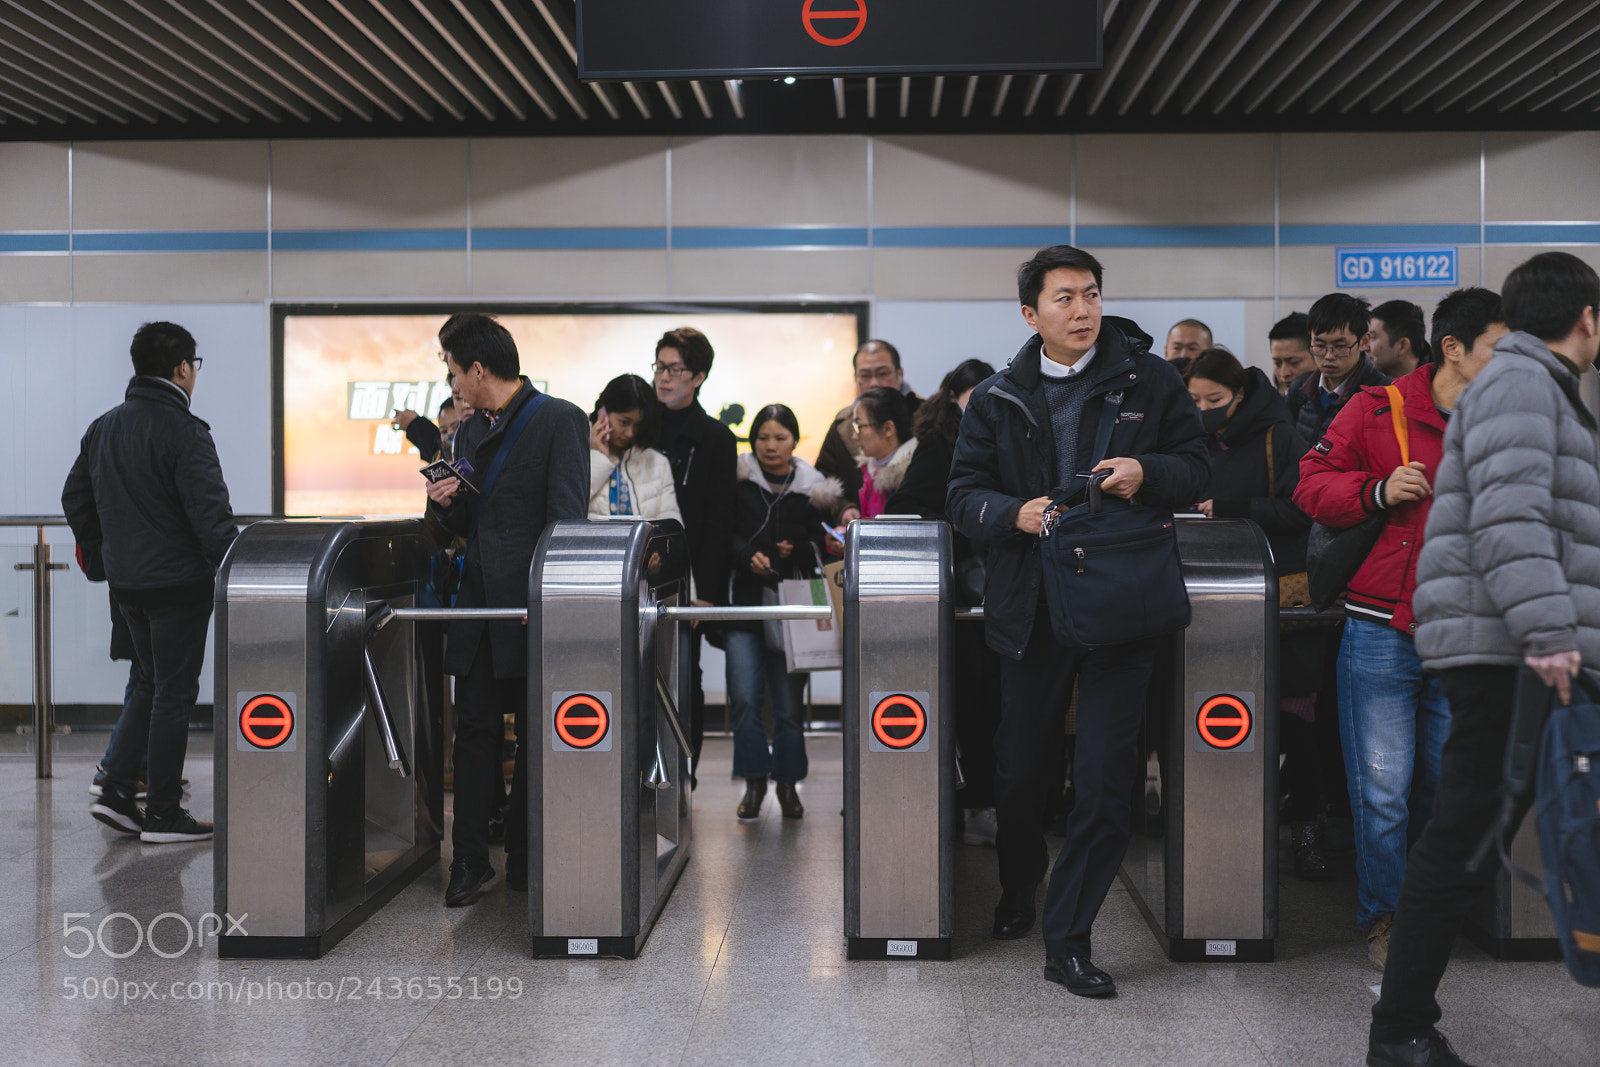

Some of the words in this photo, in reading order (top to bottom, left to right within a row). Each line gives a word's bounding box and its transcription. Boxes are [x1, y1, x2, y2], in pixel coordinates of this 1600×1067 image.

[1343, 256, 1374, 280] GD
[1380, 255, 1450, 279] 916122
[1208, 943, 1232, 952] 39G001
